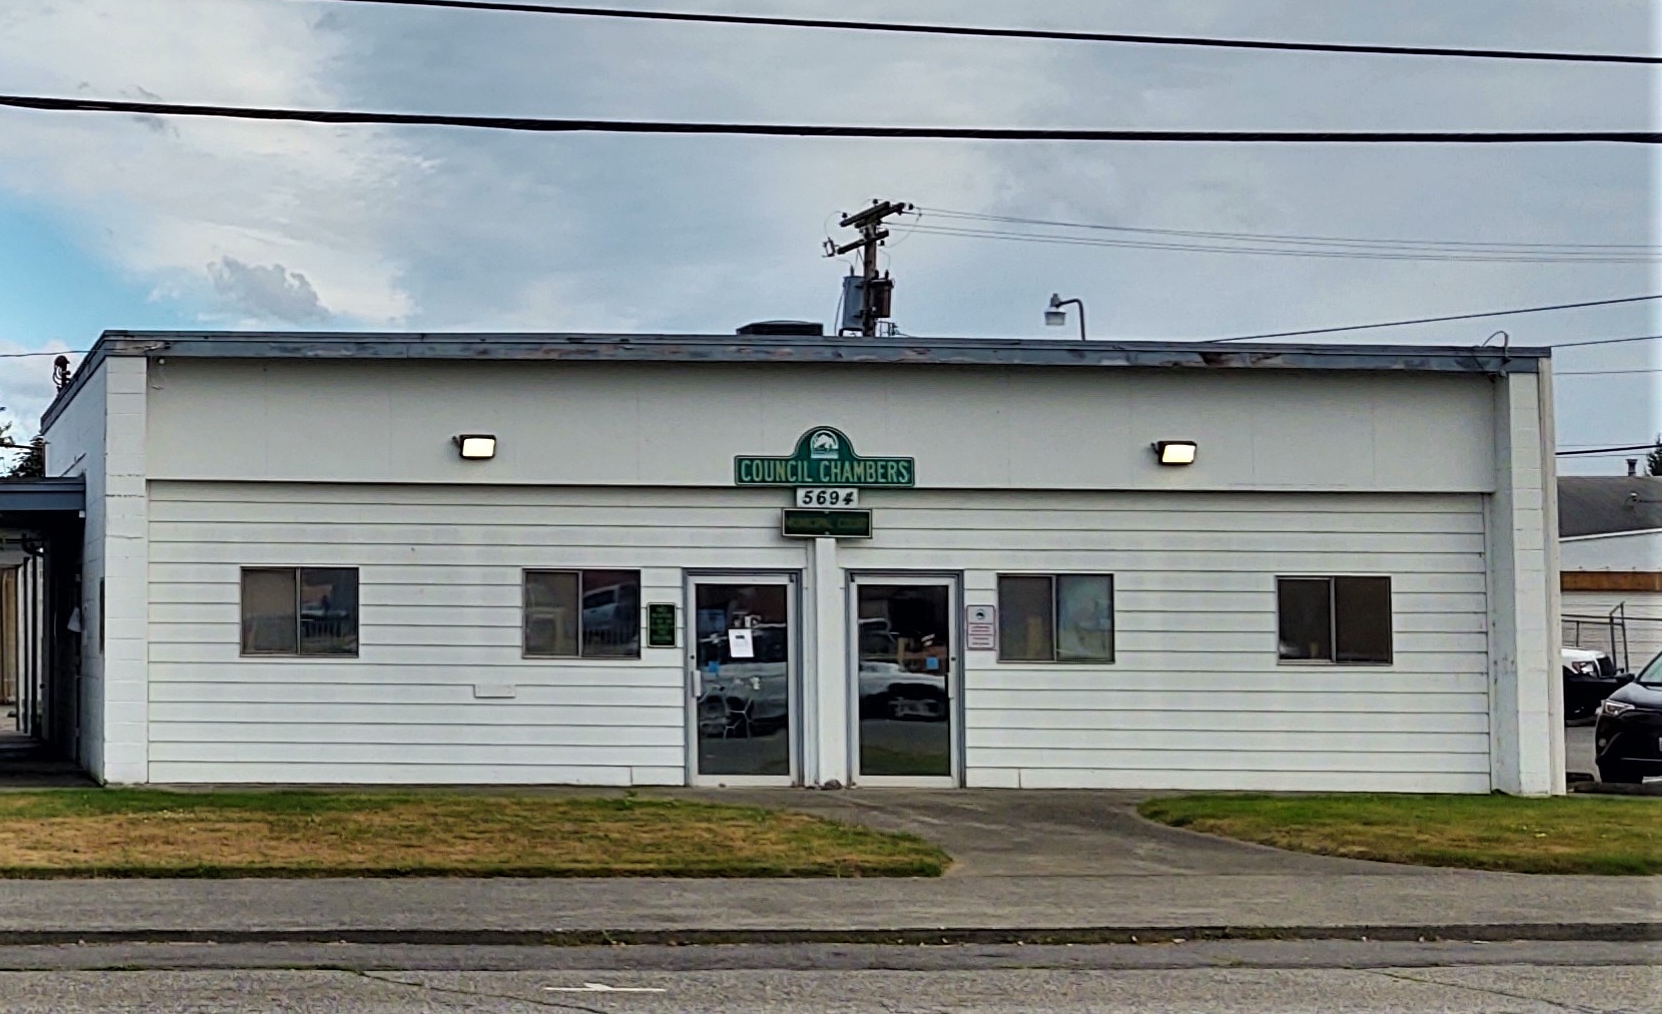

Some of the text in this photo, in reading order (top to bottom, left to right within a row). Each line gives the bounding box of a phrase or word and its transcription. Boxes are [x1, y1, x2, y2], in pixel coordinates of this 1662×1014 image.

[740, 459, 910, 483] COUNCIL CHAMBERS
[802, 490, 854, 506] 5694
